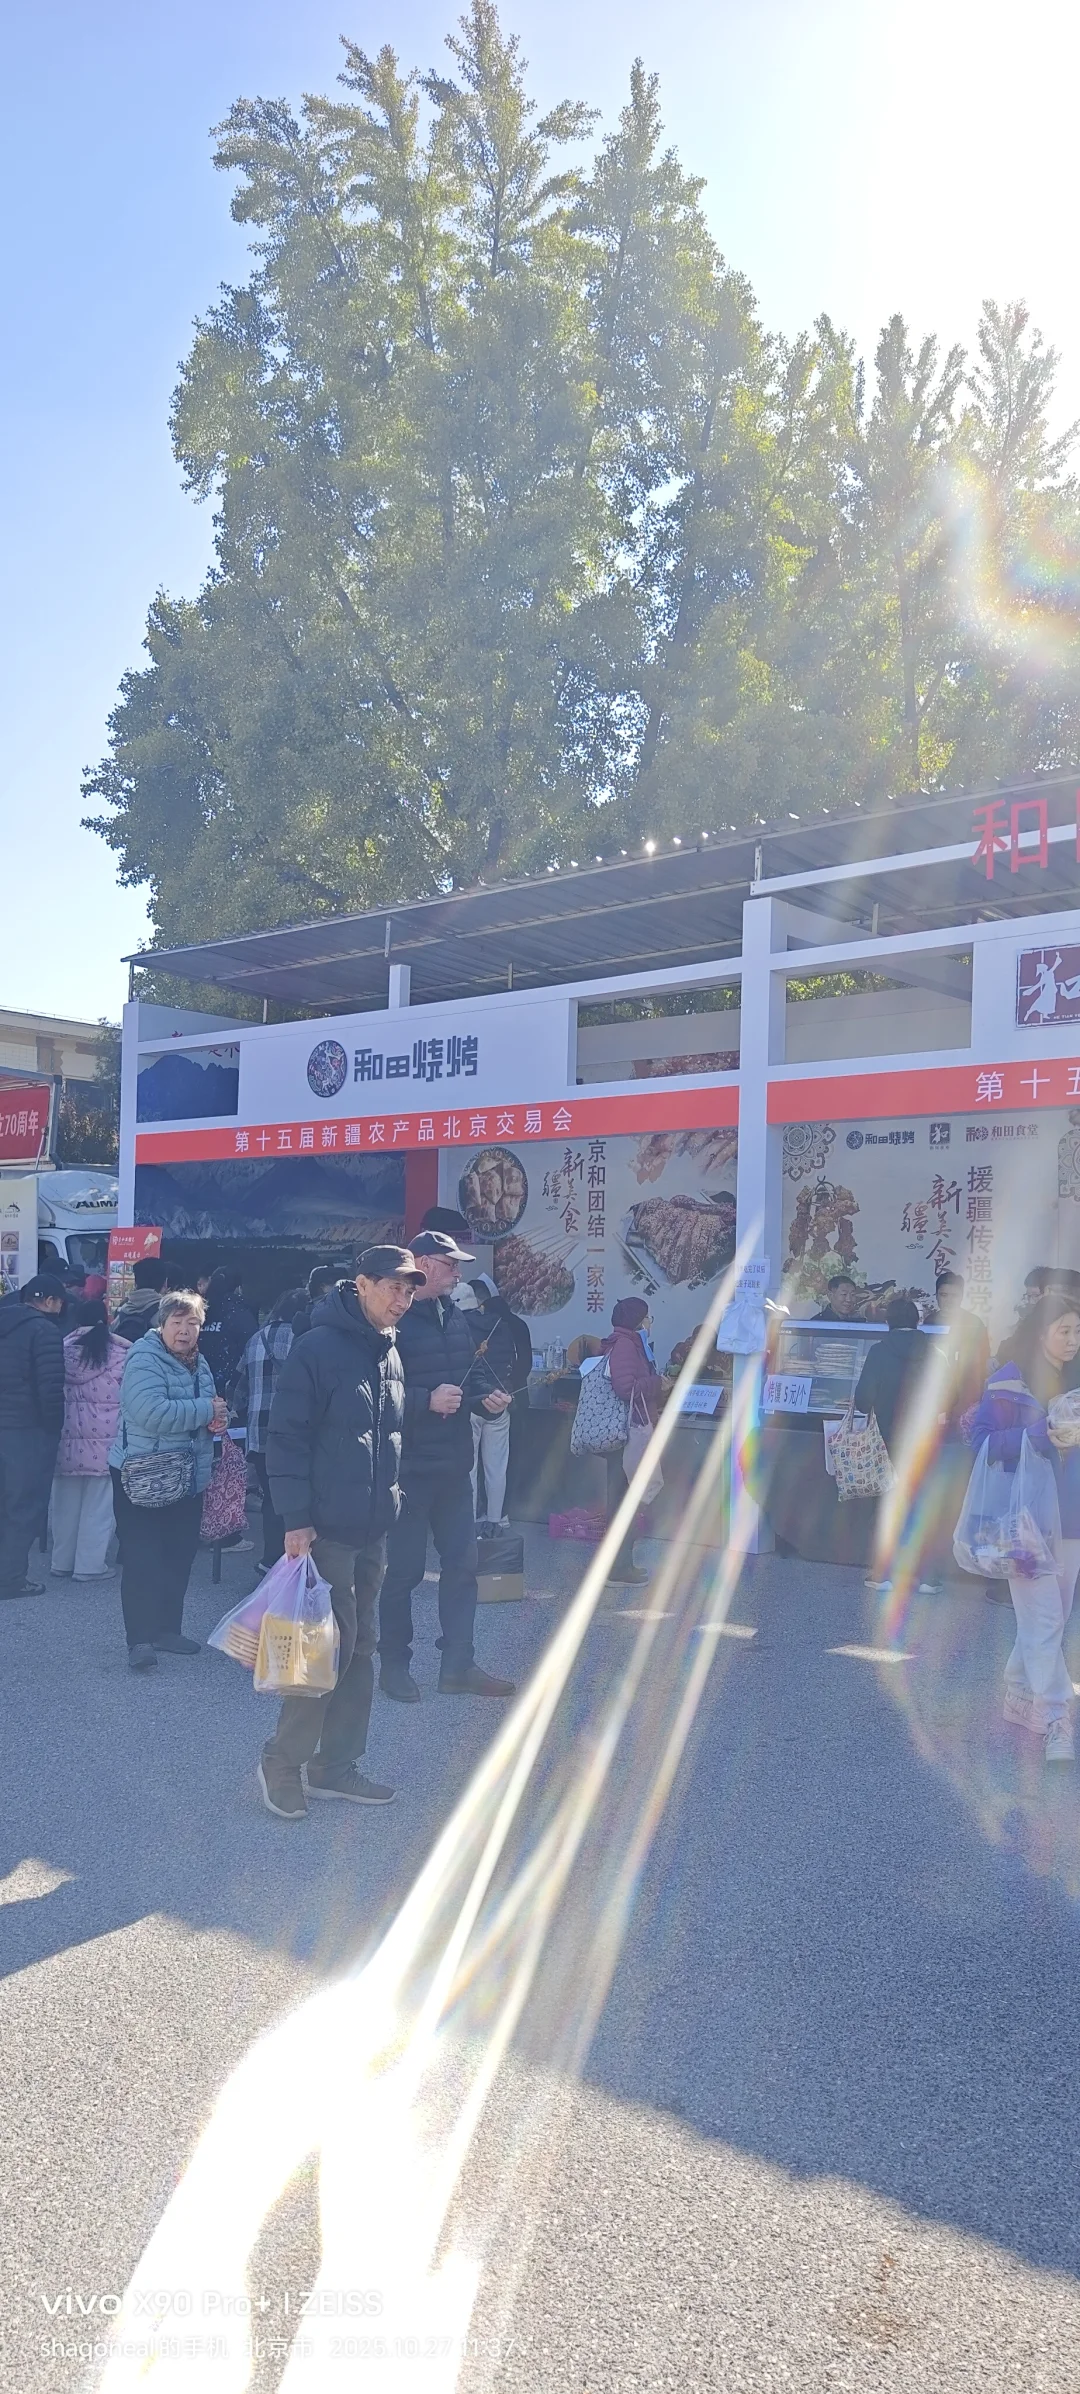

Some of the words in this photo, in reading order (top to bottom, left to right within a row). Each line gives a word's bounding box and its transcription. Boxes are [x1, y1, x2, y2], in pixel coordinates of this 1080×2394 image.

[971, 788, 1080, 880] 和
[353, 1035, 479, 1082] 和田烧烤
[234, 1106, 573, 1153] 第十五届新疆农产品北京交易会
[864, 1130, 915, 1146] 和田烧烤
[991, 1123, 1039, 1138] 和田食堂
[586, 1139, 607, 1314] 京和团结一家亲
[965, 1165, 994, 1328] 援疆传递党
